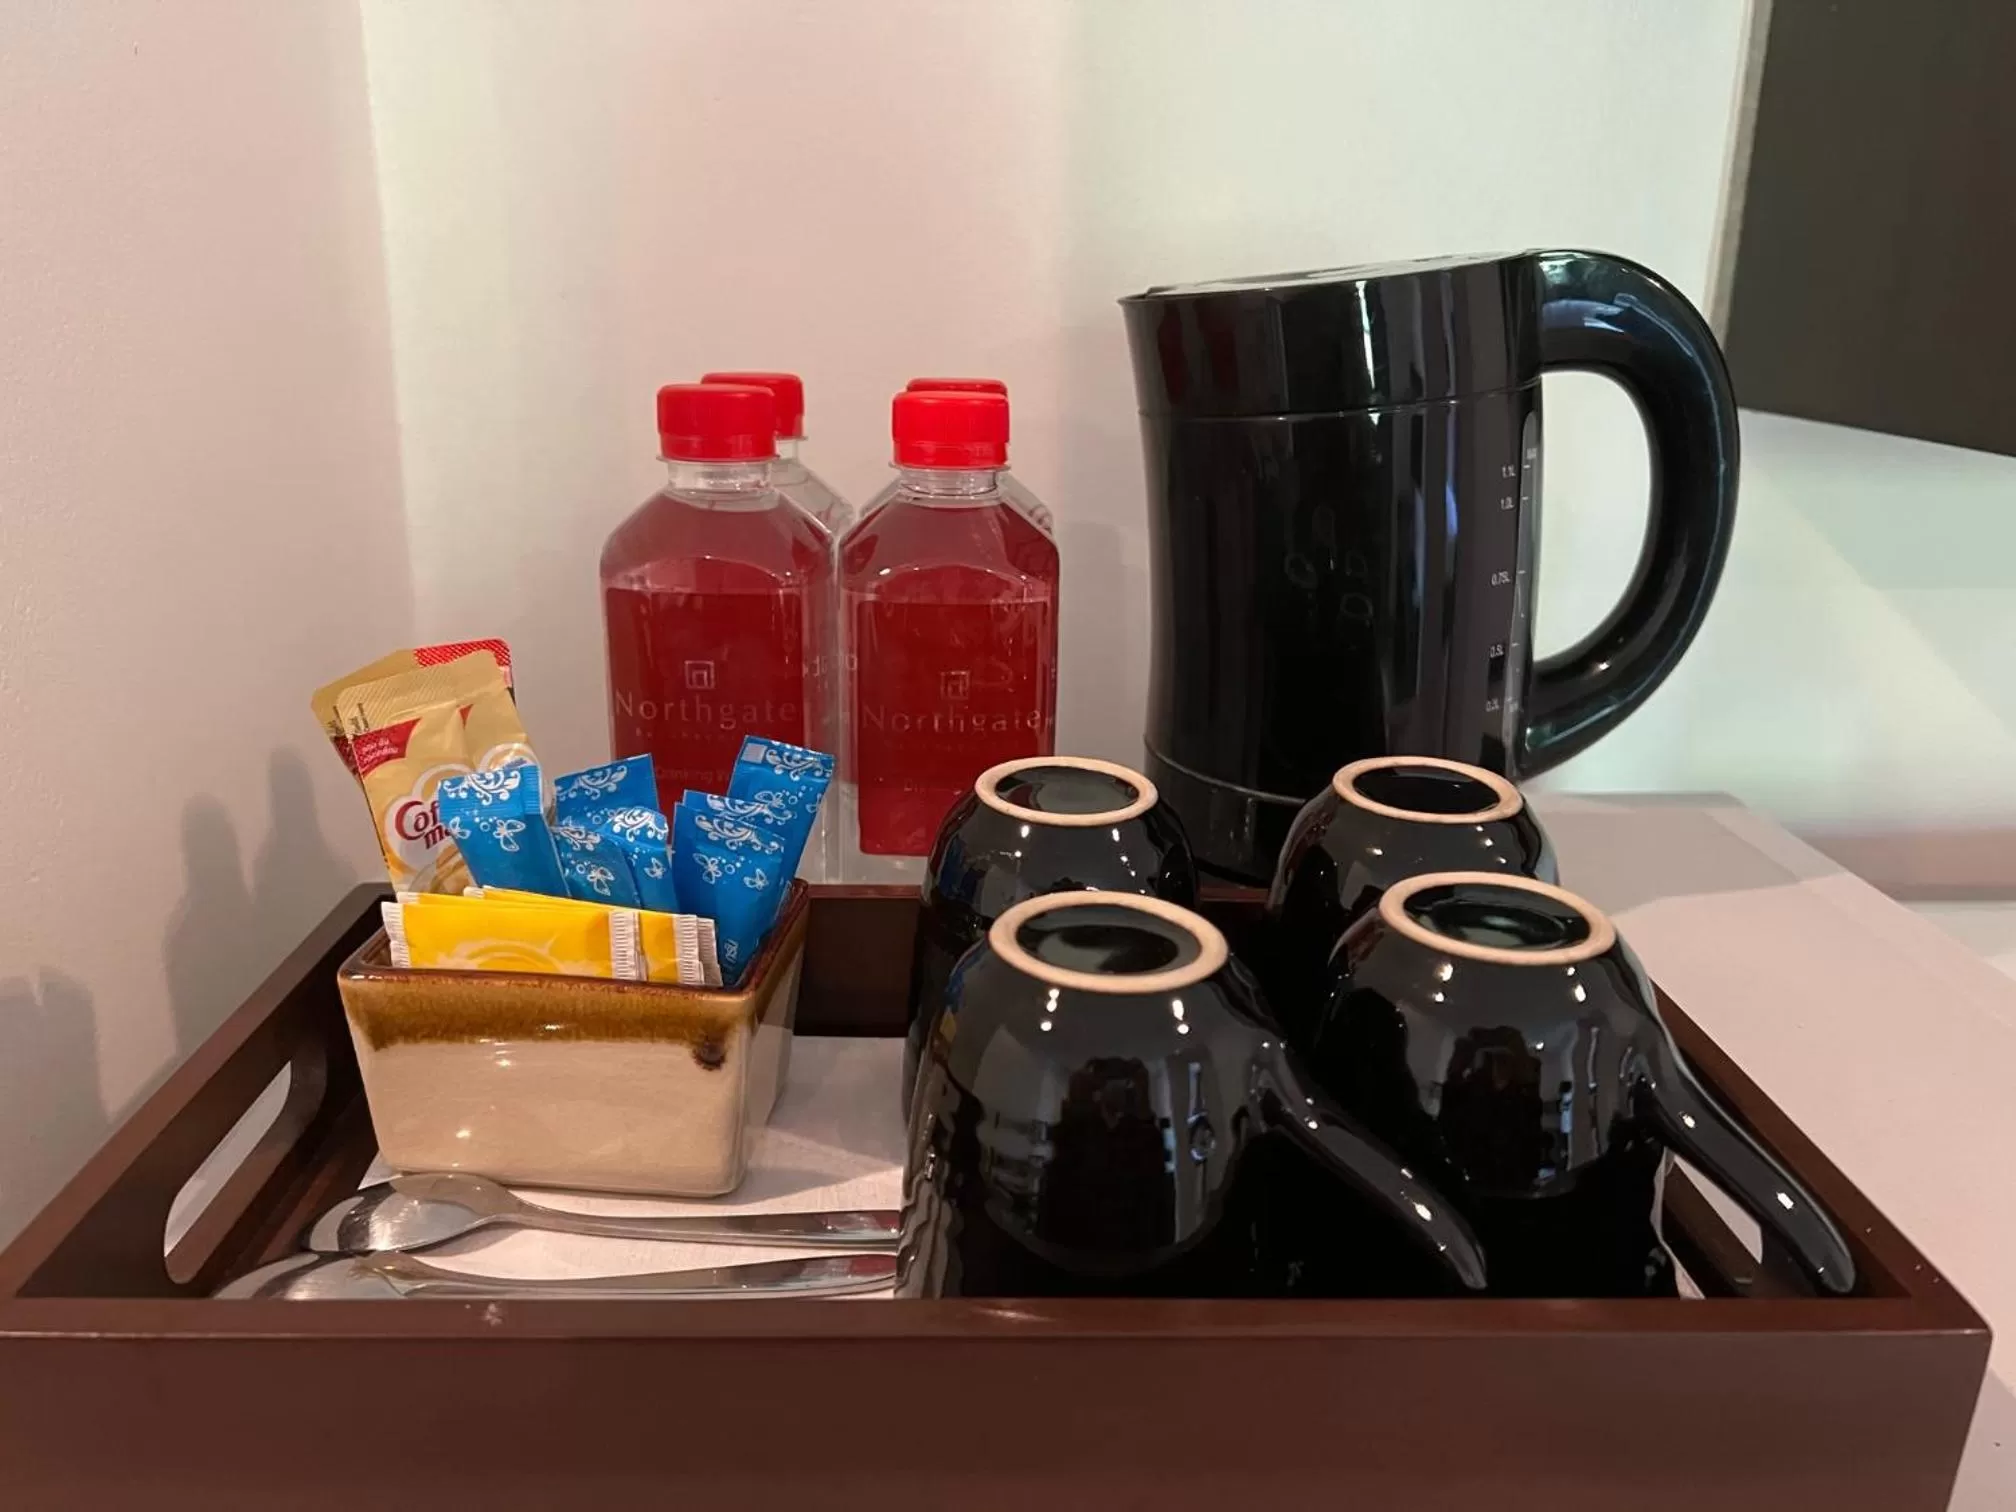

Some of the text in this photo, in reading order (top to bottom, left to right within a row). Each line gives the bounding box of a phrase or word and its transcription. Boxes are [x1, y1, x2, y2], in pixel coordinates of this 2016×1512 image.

[1491, 571, 1511, 586] 0.75L
[615, 690, 798, 730] Northgate
[862, 703, 1041, 738] Northgate
[395, 800, 440, 840] Cof
